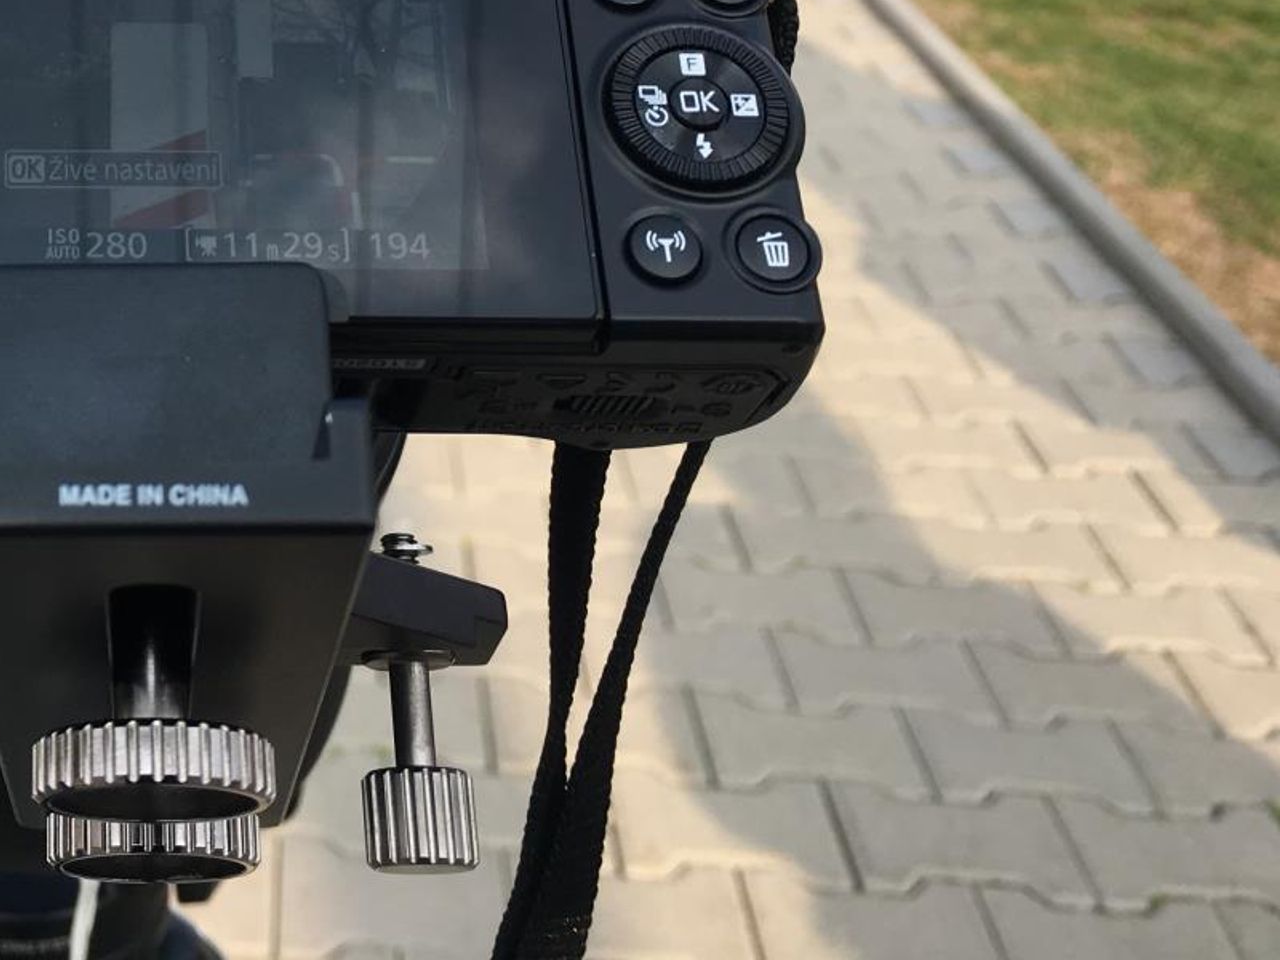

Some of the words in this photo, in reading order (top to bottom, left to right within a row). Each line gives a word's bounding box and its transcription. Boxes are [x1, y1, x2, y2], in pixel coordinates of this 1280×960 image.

[679, 90, 720, 113] OK
[12, 157, 43, 180] OK
[46, 228, 81, 244] ISO
[86, 232, 147, 259] 280
[369, 231, 431, 259] 194
[44, 246, 81, 260] AUTO
[58, 484, 133, 507] MADE
[136, 484, 165, 507] IN
[168, 484, 250, 507] CHINA
